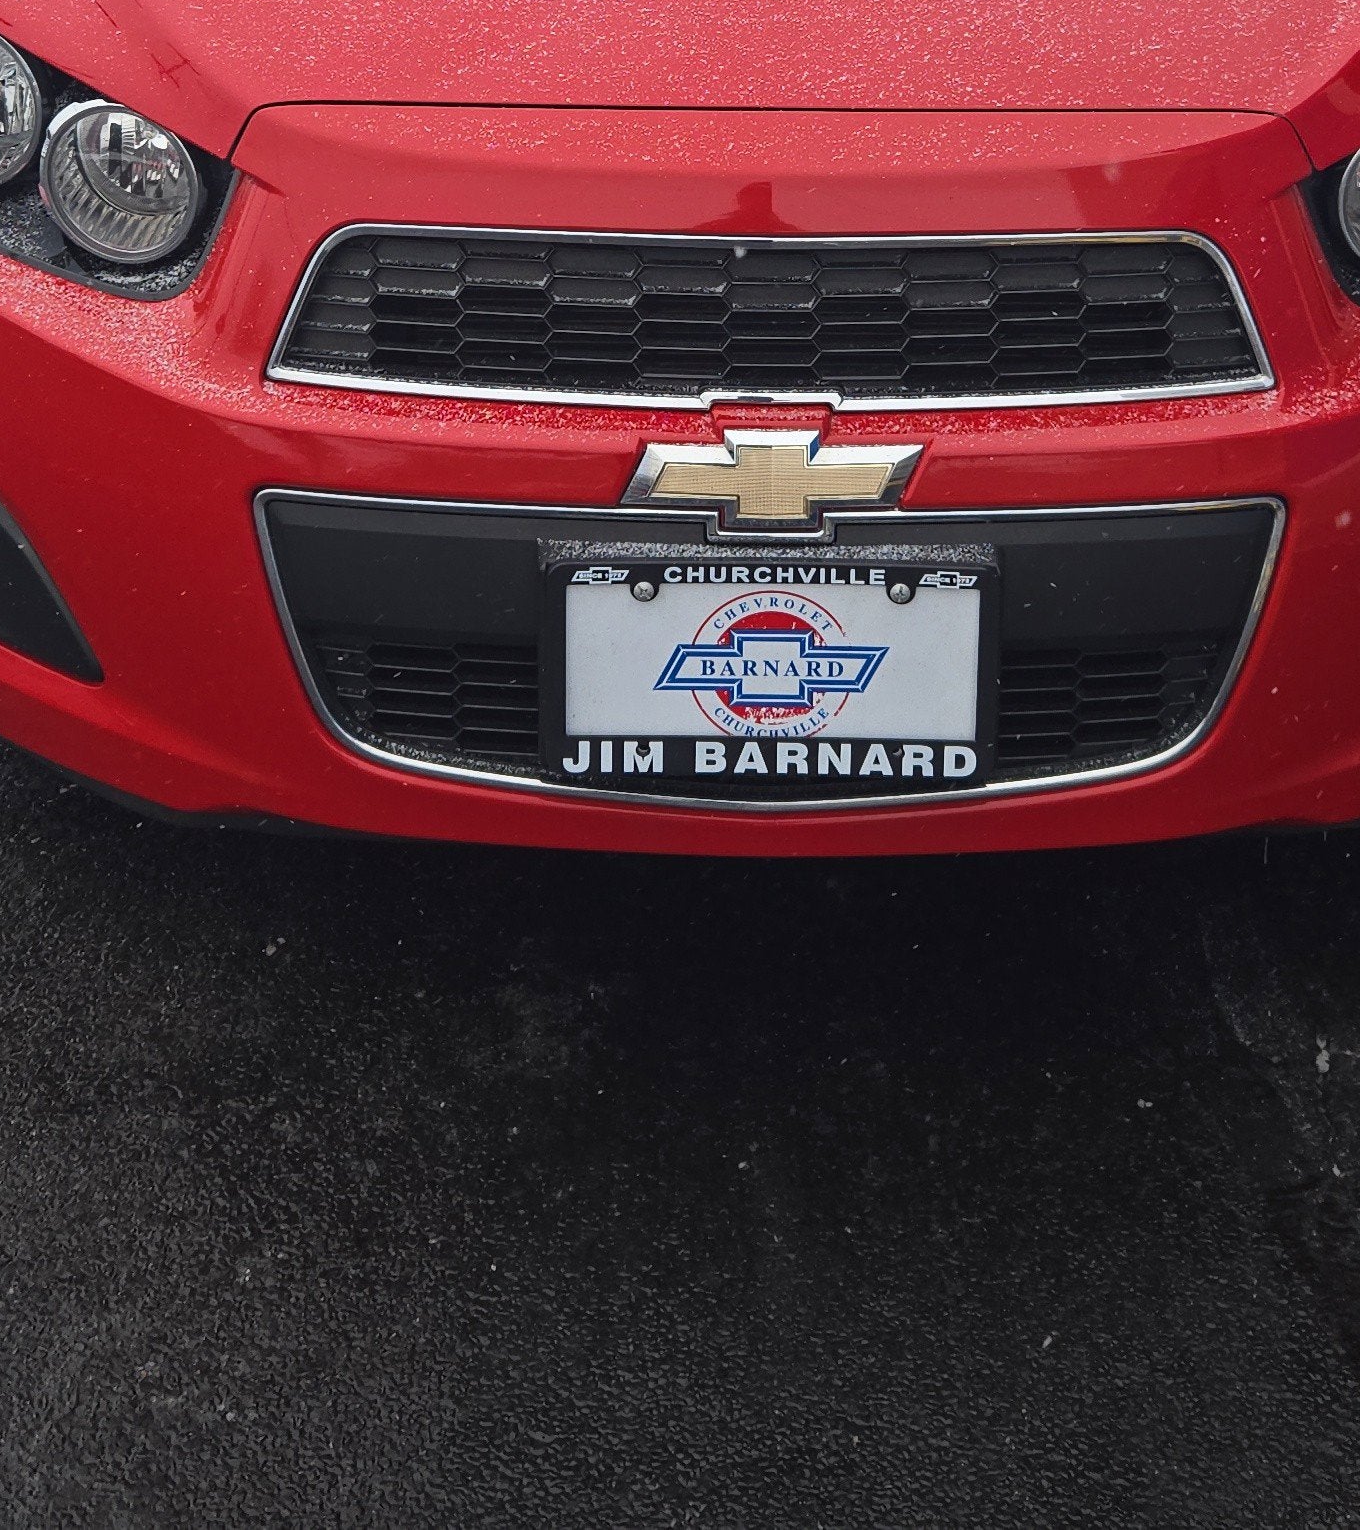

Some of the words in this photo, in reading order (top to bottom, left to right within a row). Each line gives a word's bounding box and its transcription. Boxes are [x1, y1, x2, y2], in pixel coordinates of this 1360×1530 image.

[663, 566, 887, 586] CHURCHVILLE
[713, 596, 833, 631] CHEVROLET
[700, 659, 845, 678] BARNARD
[562, 740, 664, 774] JIM
[695, 741, 978, 778] BARNARD
